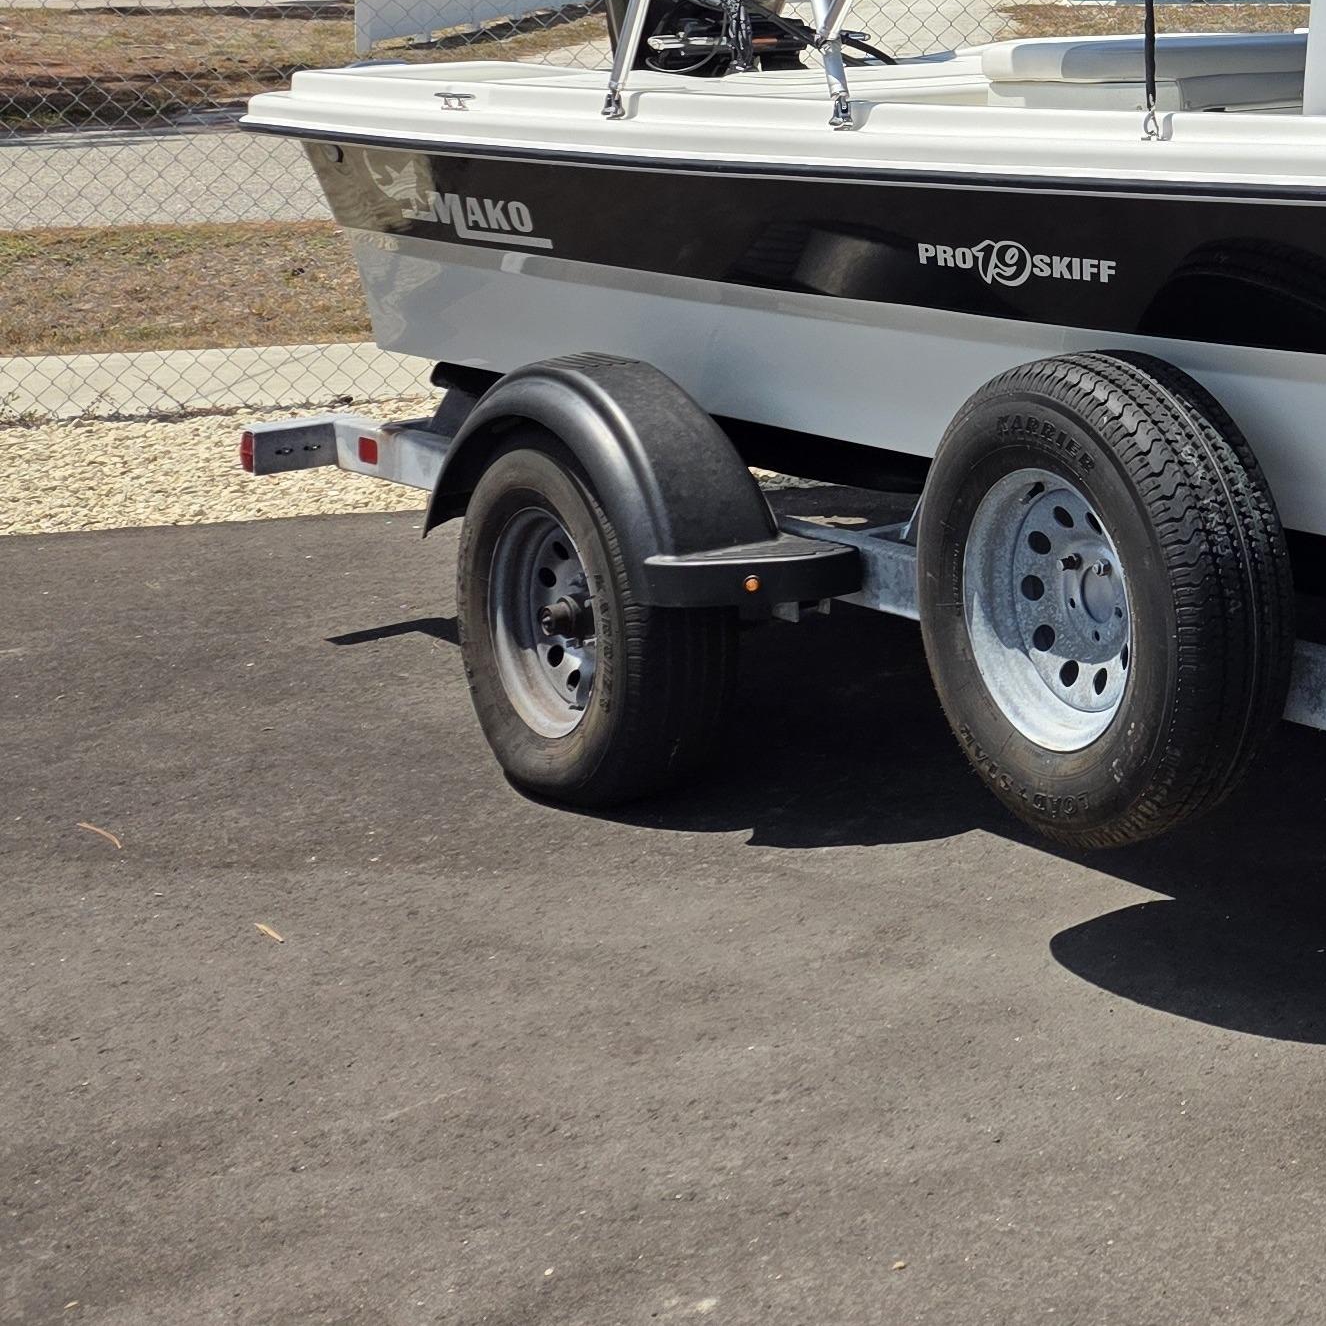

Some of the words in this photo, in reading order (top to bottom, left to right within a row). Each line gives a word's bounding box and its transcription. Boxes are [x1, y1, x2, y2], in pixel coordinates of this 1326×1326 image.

[424, 191, 553, 250] MAKO
[917, 242, 974, 269] PRO
[971, 239, 1032, 287] 19
[1032, 254, 1117, 283] SKIFF
[998, 415, 1096, 475] KARRIER
